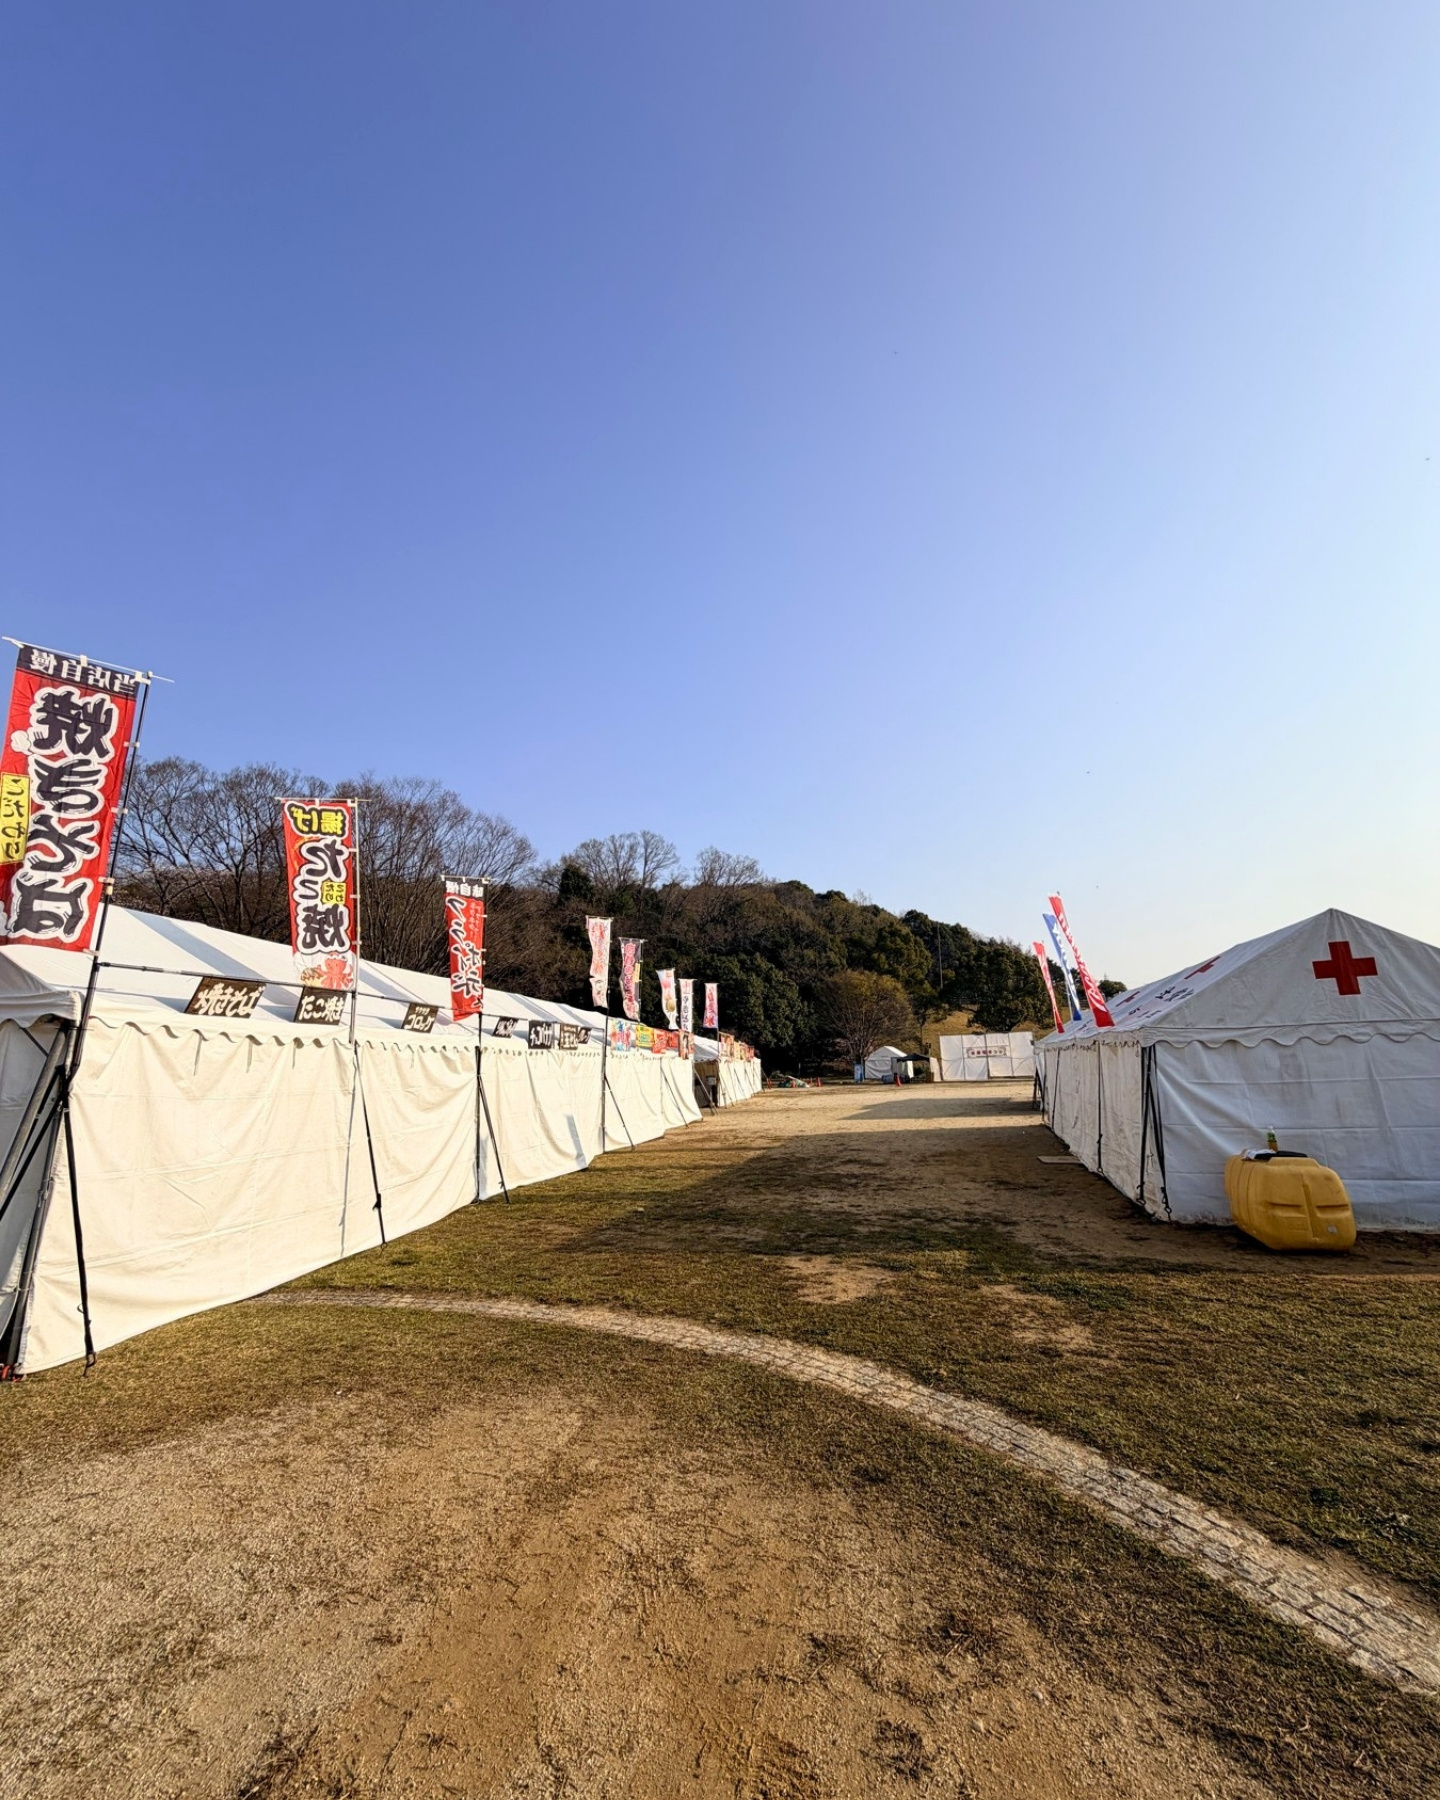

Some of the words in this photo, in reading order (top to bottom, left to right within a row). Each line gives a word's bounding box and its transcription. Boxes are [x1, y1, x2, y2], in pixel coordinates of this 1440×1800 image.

[195, 982, 266, 1016] 焼きそば
[298, 995, 344, 1022] たこ焼き
[404, 1014, 436, 1032] コロッケ
